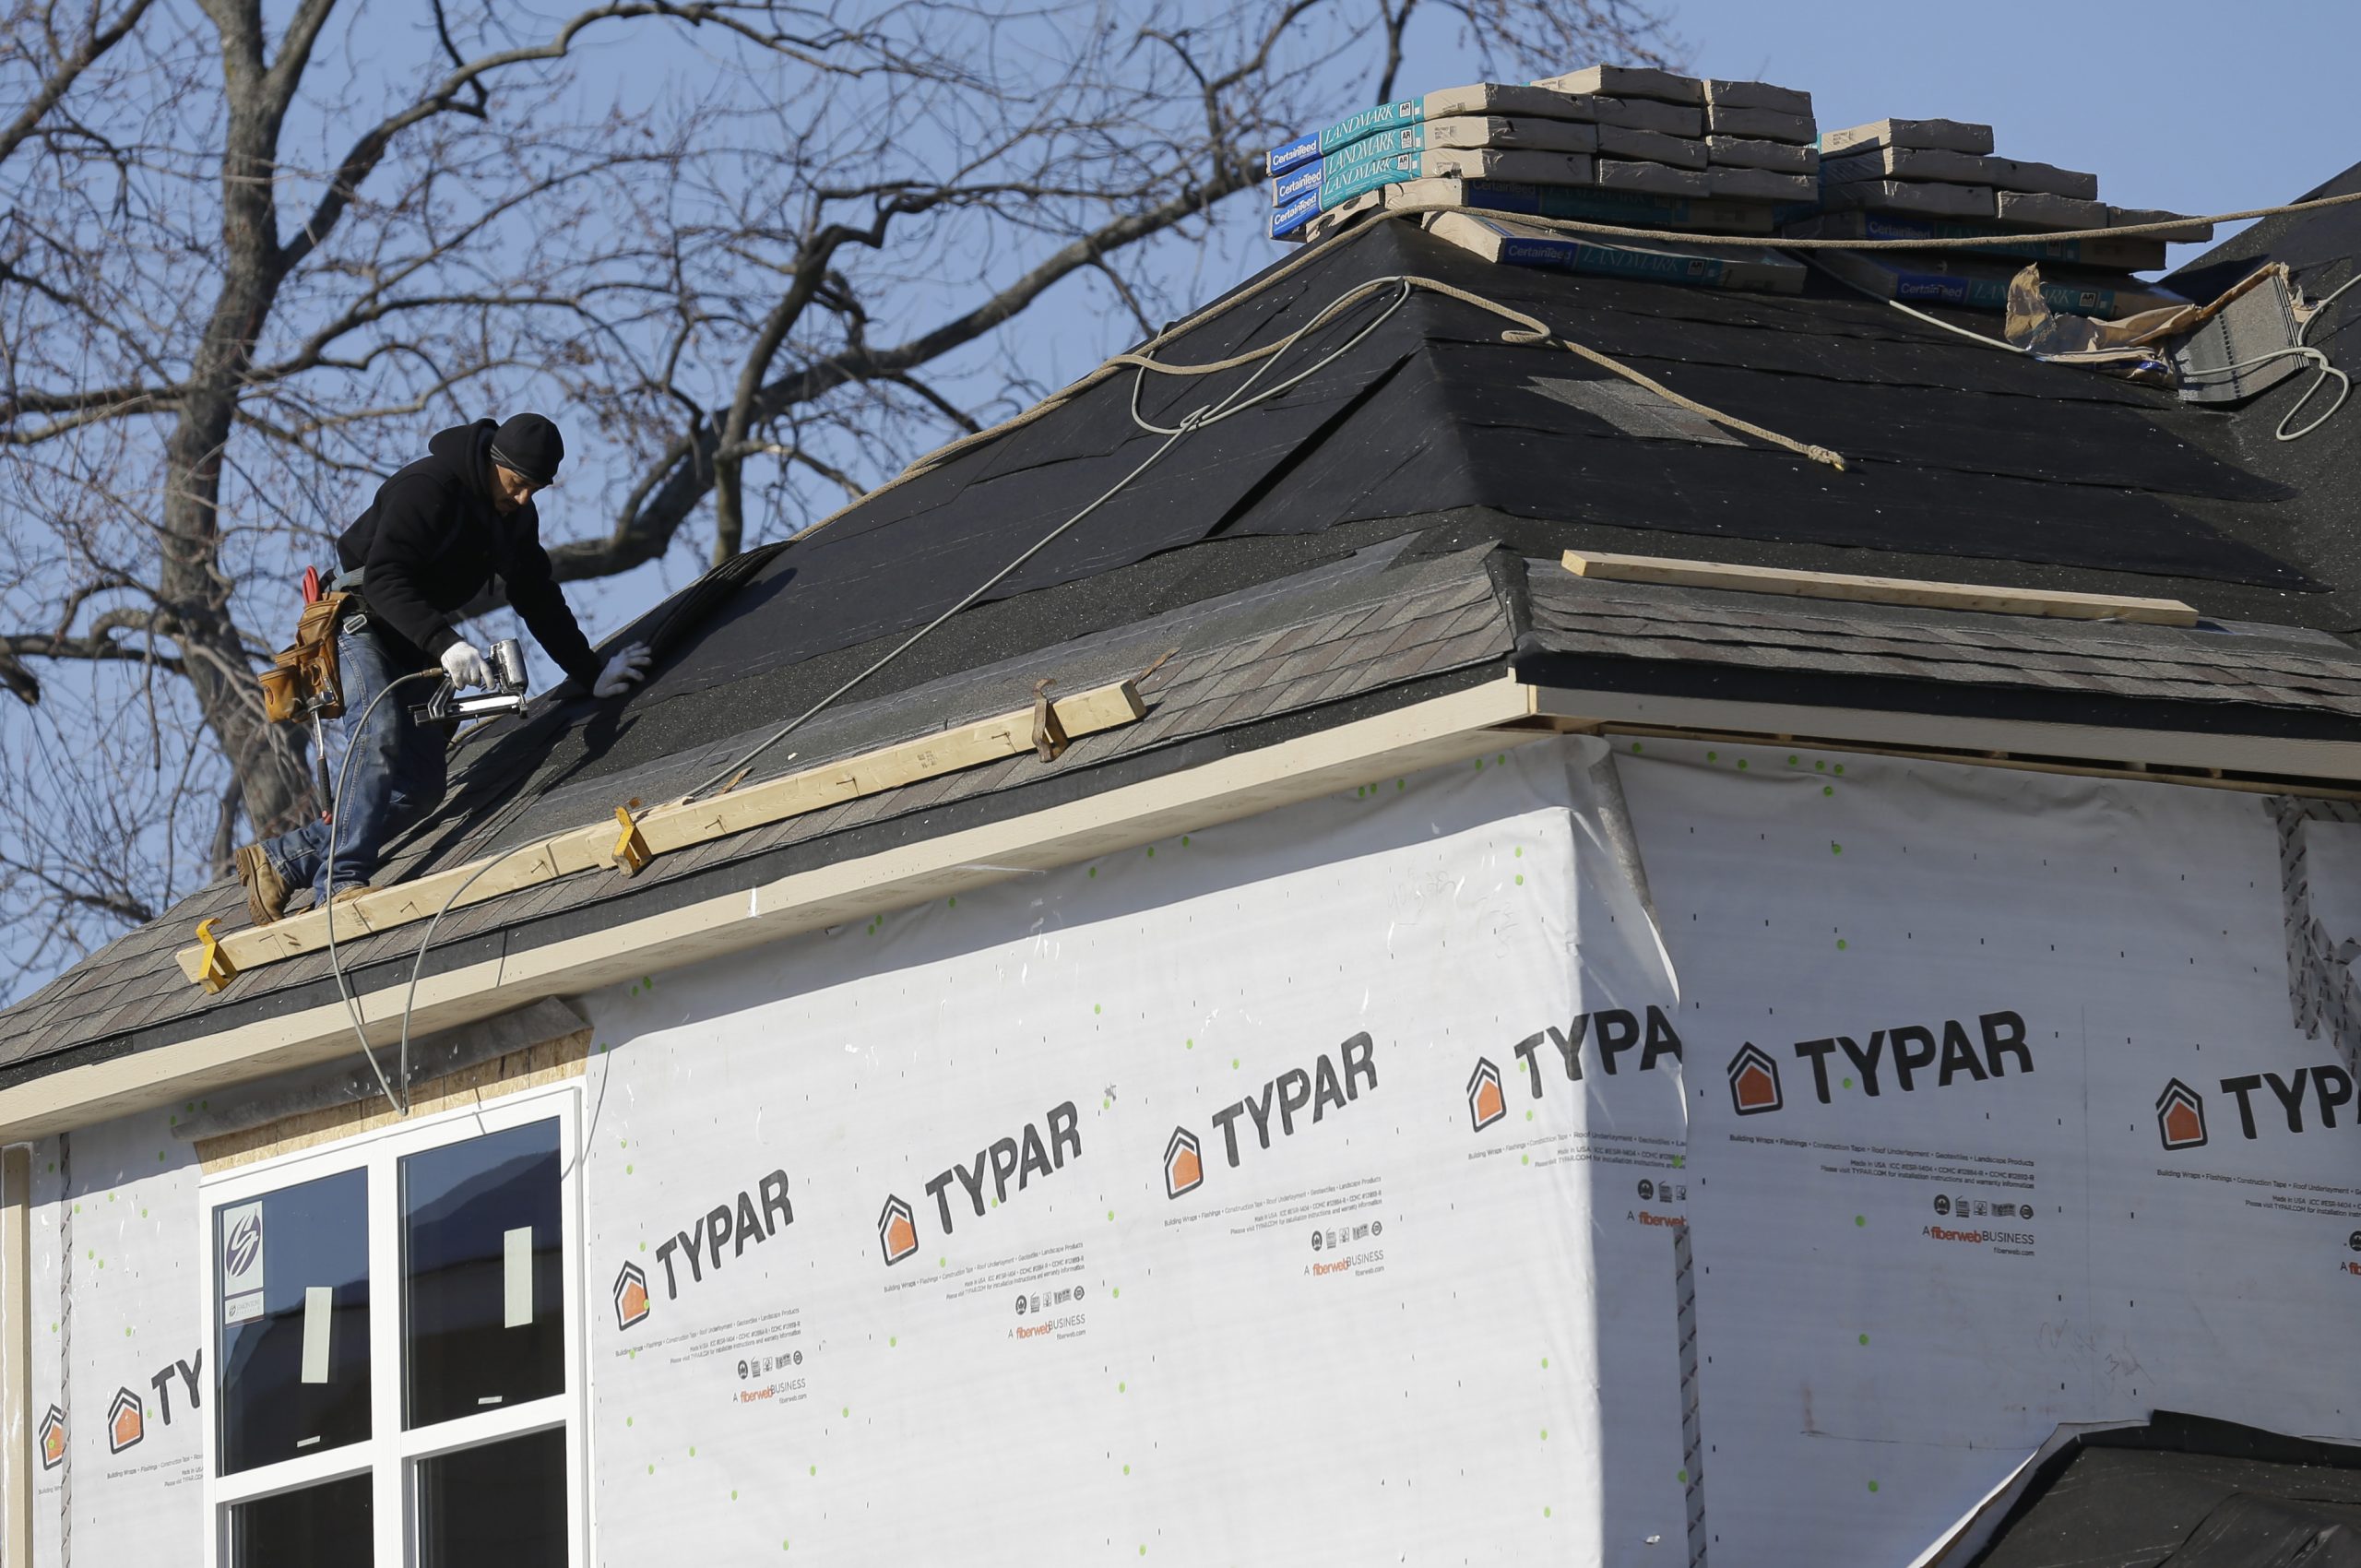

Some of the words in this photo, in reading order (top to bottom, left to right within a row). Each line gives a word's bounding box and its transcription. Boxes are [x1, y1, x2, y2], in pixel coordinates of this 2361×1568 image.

[1324, 104, 1394, 146] LANDMARK
[1401, 103, 1410, 112] AR
[1273, 140, 1317, 166] CertainTeed
[1328, 130, 1395, 175] LANDMARK
[1402, 131, 1412, 140] AR
[1279, 169, 1322, 197] CertainTeed
[1324, 158, 1392, 195] LANDMARK
[1399, 155, 1408, 164] AR
[1275, 193, 1317, 225] CertainTeed
[1869, 220, 1931, 239] CertainTeed
[1508, 245, 1572, 261] CertainTeed
[1584, 249, 1678, 272] LANDMARK
[1513, 1004, 1683, 1099] TYPA
[1794, 1010, 2035, 1104] TYPAR
[1211, 1030, 1378, 1169] TYPAR
[2220, 1064, 2361, 1140] TYP
[925, 1100, 1082, 1235] TYPAR
[1626, 1210, 1635, 1221] A
[656, 1169, 794, 1301] TYPAR
[1922, 1226, 1931, 1237] A
[1931, 1226, 1982, 1242] fiberweb
[1982, 1230, 2035, 1245] BUSINESS
[1303, 1265, 1311, 1276] A
[1312, 1257, 1348, 1277] fiberweb
[1347, 1250, 1384, 1266] BUSINESS
[2340, 1262, 2348, 1272] A
[1007, 1328, 1014, 1338] A
[1016, 1322, 1050, 1339] fiberweb
[1049, 1313, 1086, 1331] BUSINESS
[732, 1393, 739, 1403] A
[741, 1386, 773, 1404] fiberweb
[771, 1379, 806, 1395] BUSINESS
